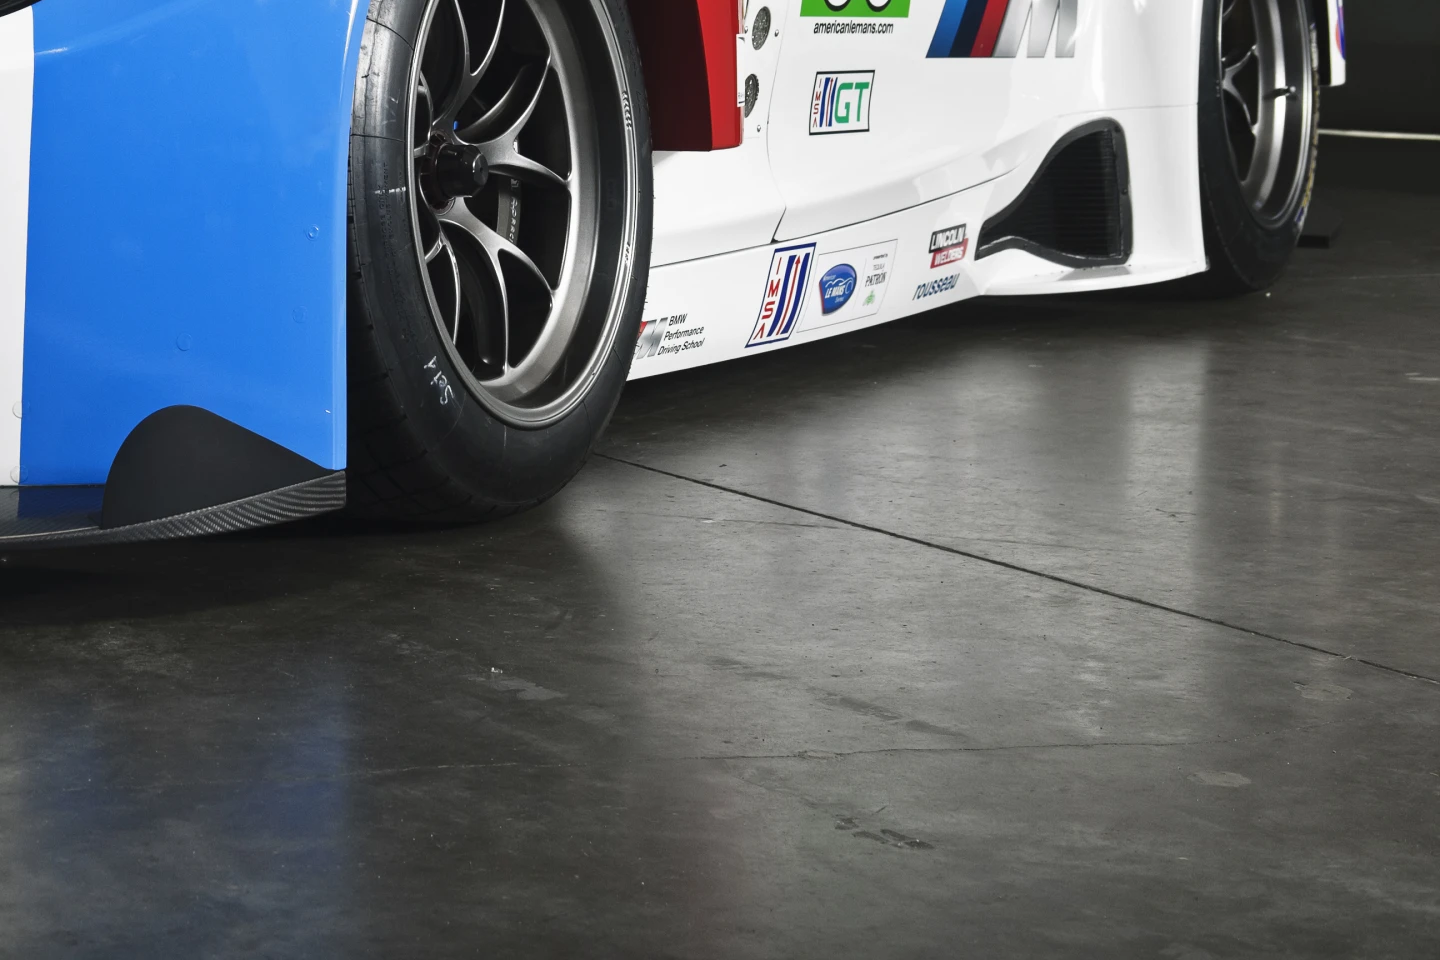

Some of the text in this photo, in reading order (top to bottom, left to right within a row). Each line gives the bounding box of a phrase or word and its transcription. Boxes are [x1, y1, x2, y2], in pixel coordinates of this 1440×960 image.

[813, 20, 894, 34] americanlemans.com
[812, 78, 870, 128] IMSA GT
[930, 226, 965, 250] LINCOLN
[934, 246, 964, 266] WELDERS
[912, 273, 960, 301] rousseau
[753, 256, 782, 340] IMSA
[668, 313, 688, 327] BMW
[663, 326, 705, 341] Performance
[657, 338, 706, 356] Driving School
